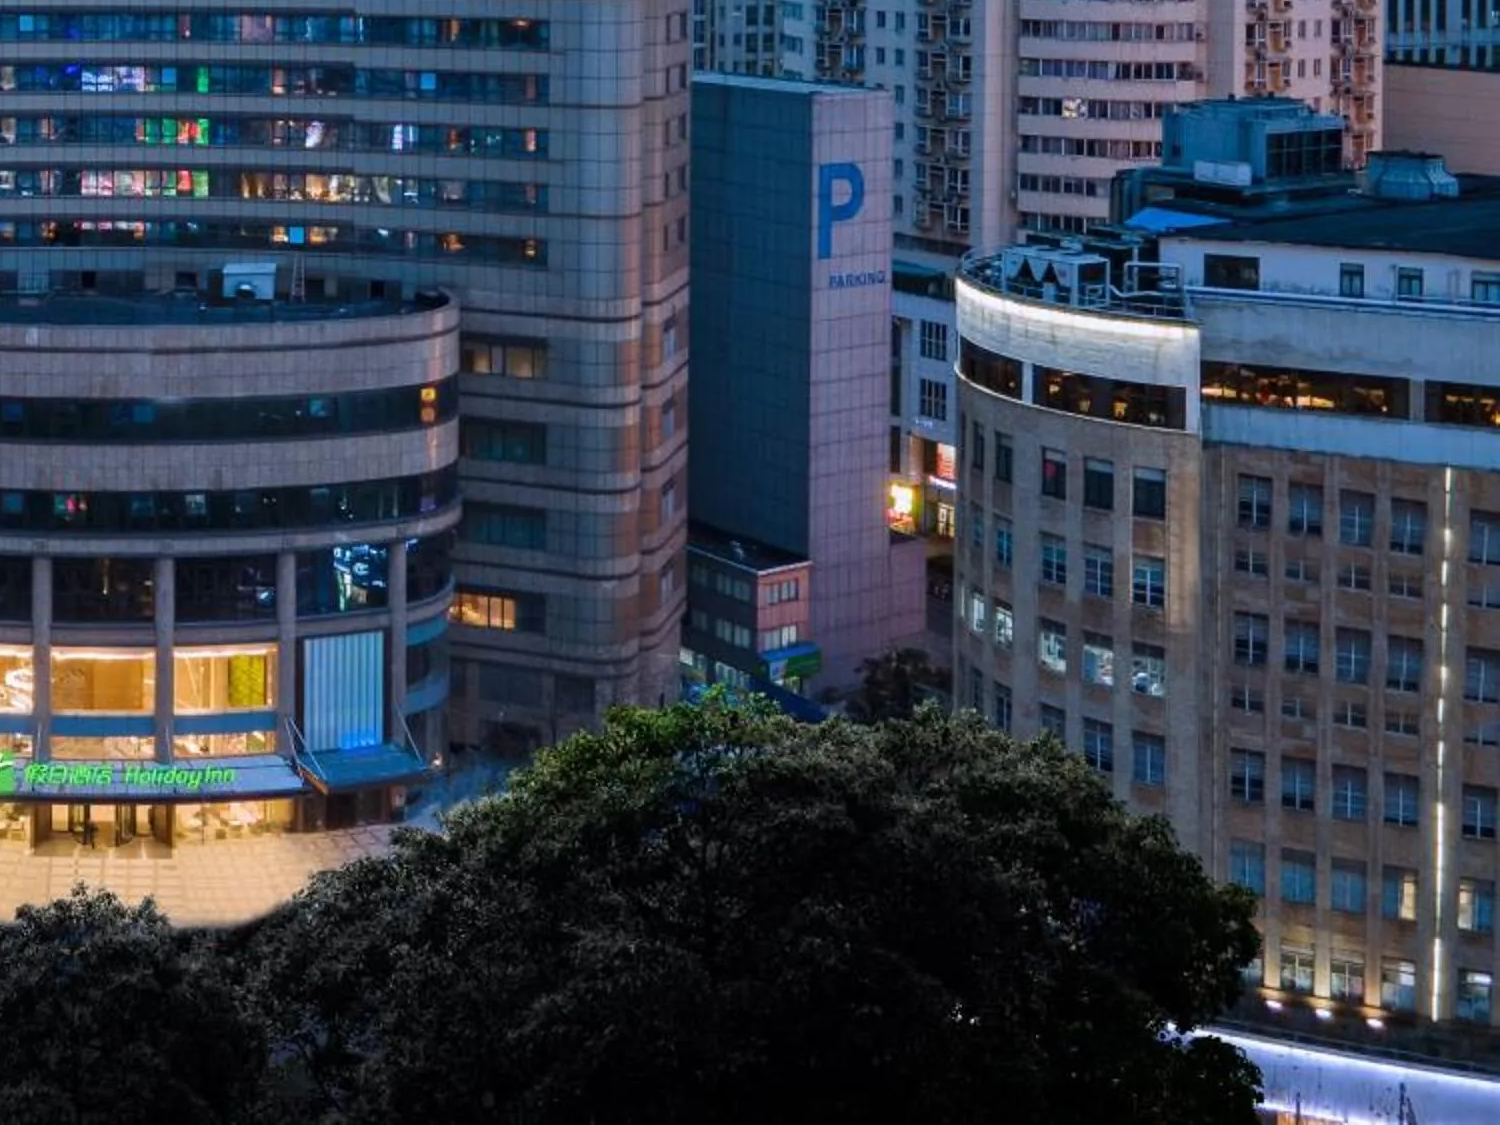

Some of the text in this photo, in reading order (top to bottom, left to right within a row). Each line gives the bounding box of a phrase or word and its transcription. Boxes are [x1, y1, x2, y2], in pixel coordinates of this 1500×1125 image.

[817, 161, 866, 261] P
[829, 270, 886, 288] PARKING
[124, 765, 236, 789] Holiday Inn
